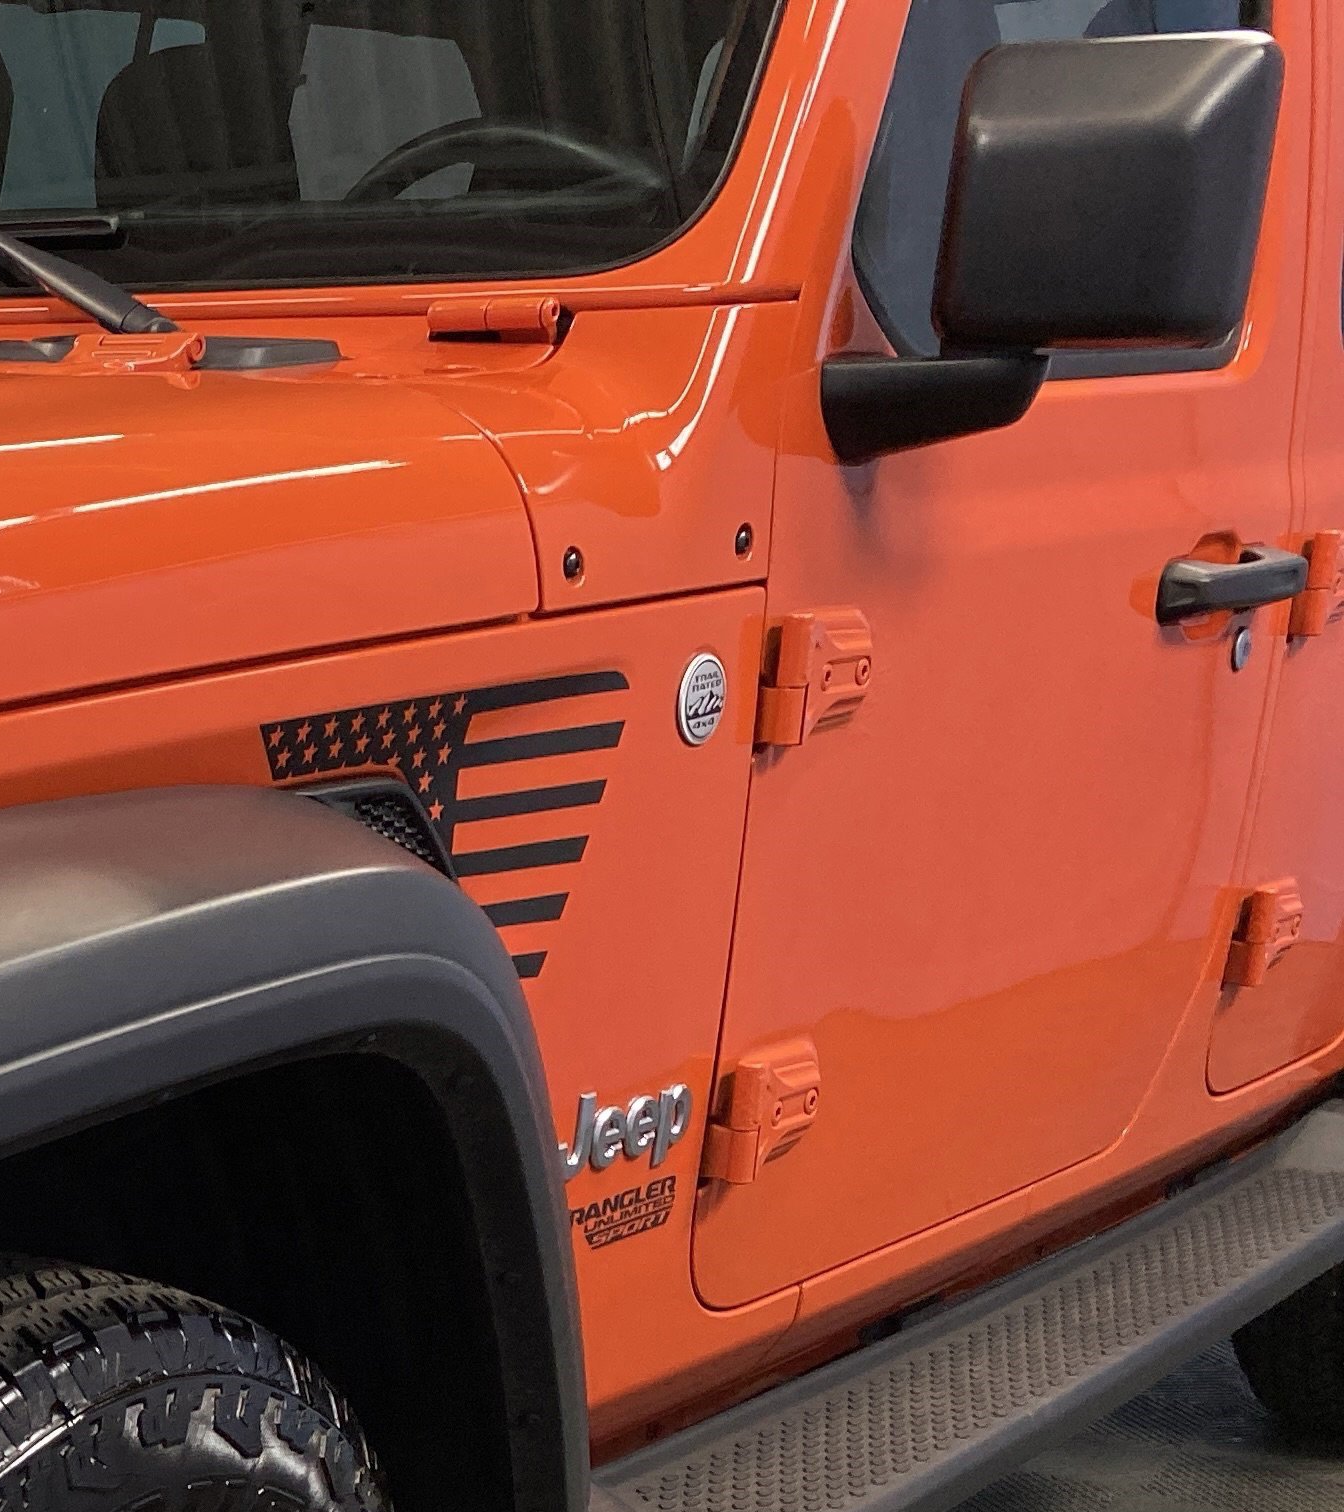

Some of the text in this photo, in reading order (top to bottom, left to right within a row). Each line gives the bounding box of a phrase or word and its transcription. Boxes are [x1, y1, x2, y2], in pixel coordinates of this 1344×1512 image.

[692, 678, 722, 693] RATED
[695, 670, 719, 683] TRAIL
[558, 1083, 693, 1180] Jeep
[569, 1175, 676, 1227] RANGLER
[584, 1194, 675, 1234] UNLIMITED
[589, 1207, 670, 1249] SPORT
